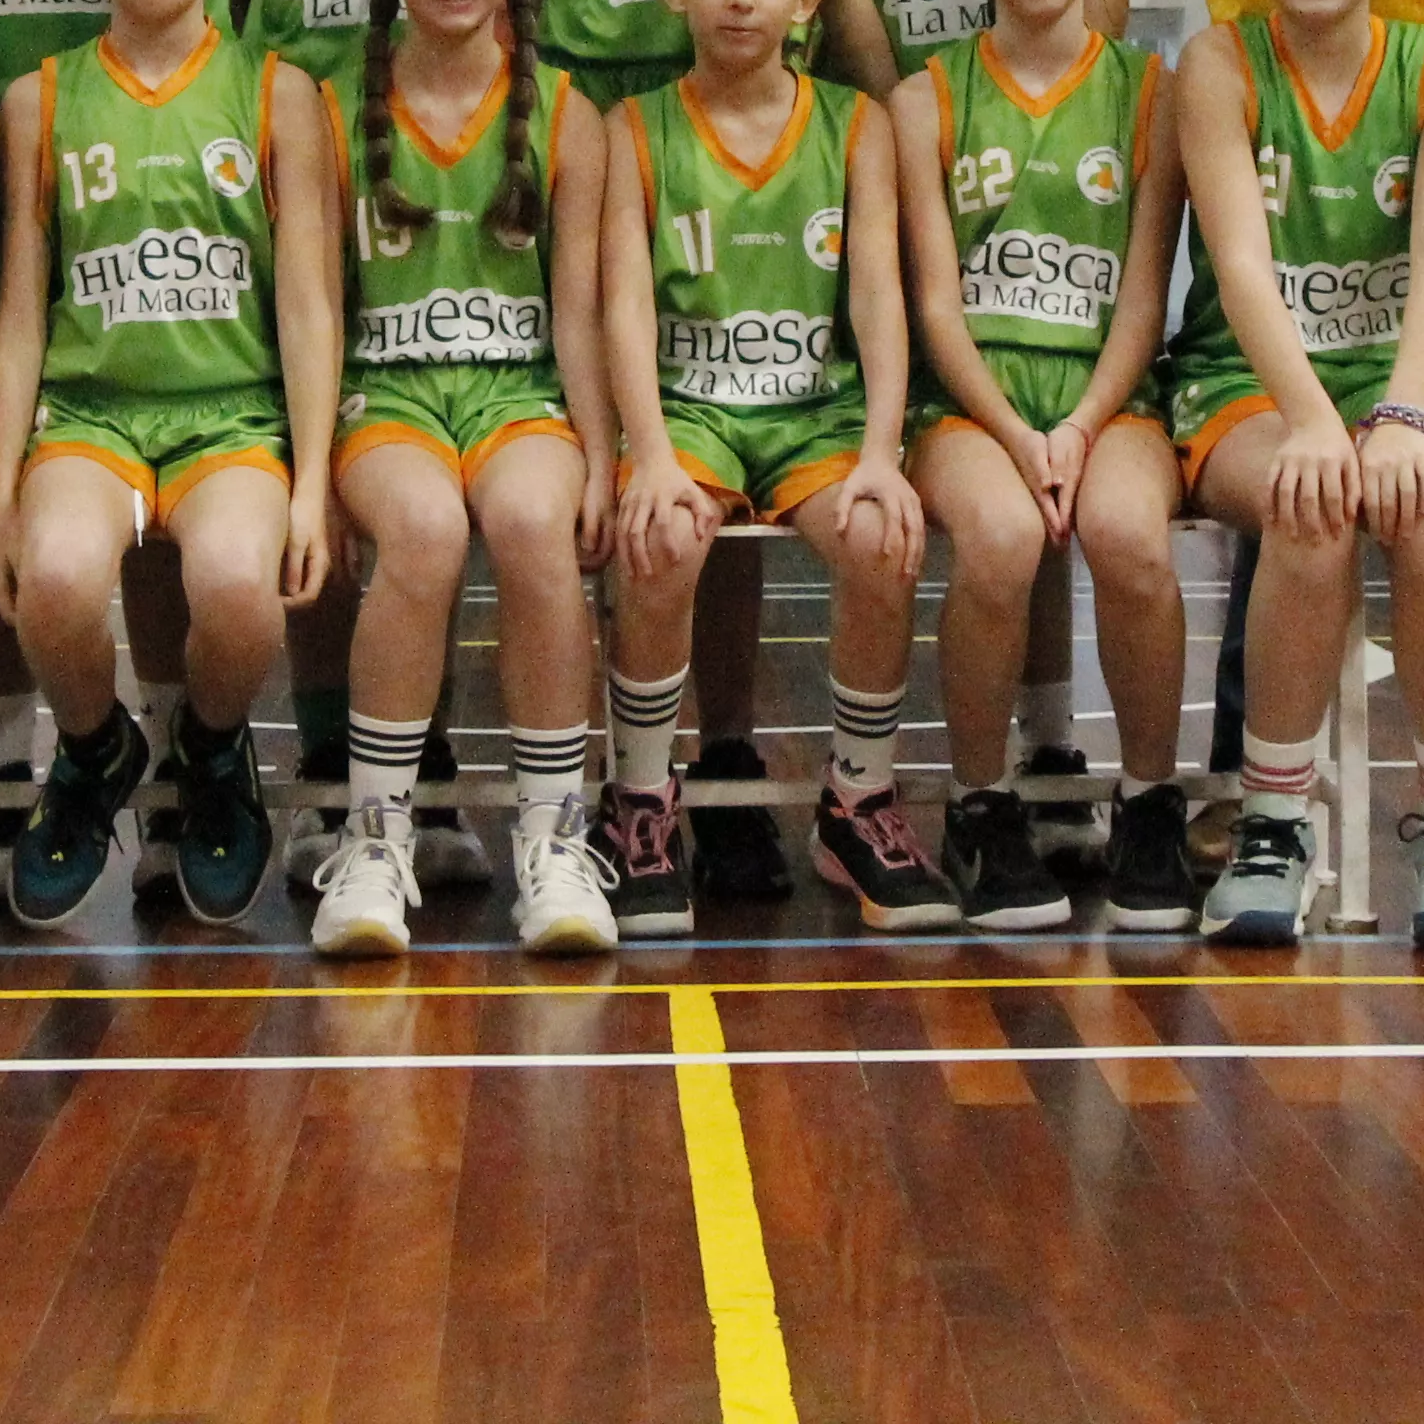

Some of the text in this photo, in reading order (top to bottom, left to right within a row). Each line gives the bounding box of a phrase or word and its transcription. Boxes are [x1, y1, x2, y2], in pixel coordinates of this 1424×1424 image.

[62, 141, 119, 211] 13
[953, 146, 1014, 216] 22
[672, 207, 715, 276] 11
[961, 237, 1113, 296] uesca
[361, 295, 543, 353] Huesca
